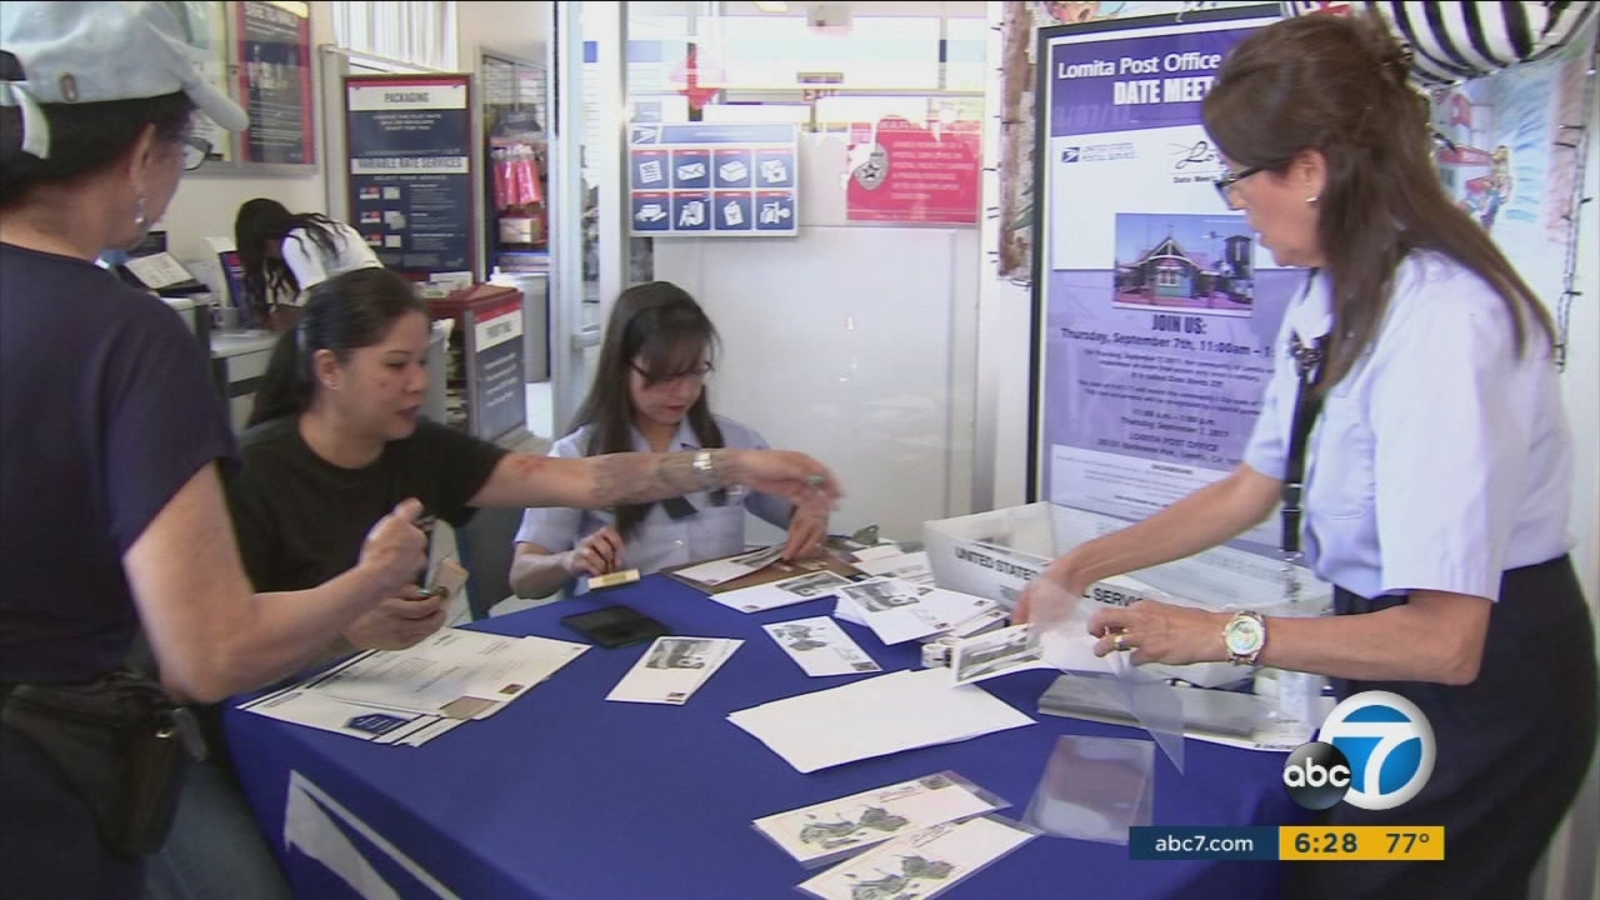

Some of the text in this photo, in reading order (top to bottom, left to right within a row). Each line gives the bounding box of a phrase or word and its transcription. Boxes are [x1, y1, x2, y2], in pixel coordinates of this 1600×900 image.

[1058, 52, 1221, 79] Lomita Post Office
[384, 92, 430, 104] PACKAGING
[1113, 76, 1216, 105] DATE MEET
[1194, 174, 1217, 183] Meet
[1151, 314, 1207, 334] JOIN US:
[1061, 327, 1111, 345] Thursday,
[1112, 332, 1171, 348] September
[1173, 338, 1196, 351] 7th,
[1199, 340, 1250, 355] 11:00am
[955, 547, 994, 569] UNITED
[1094, 587, 1144, 607] SERVI
